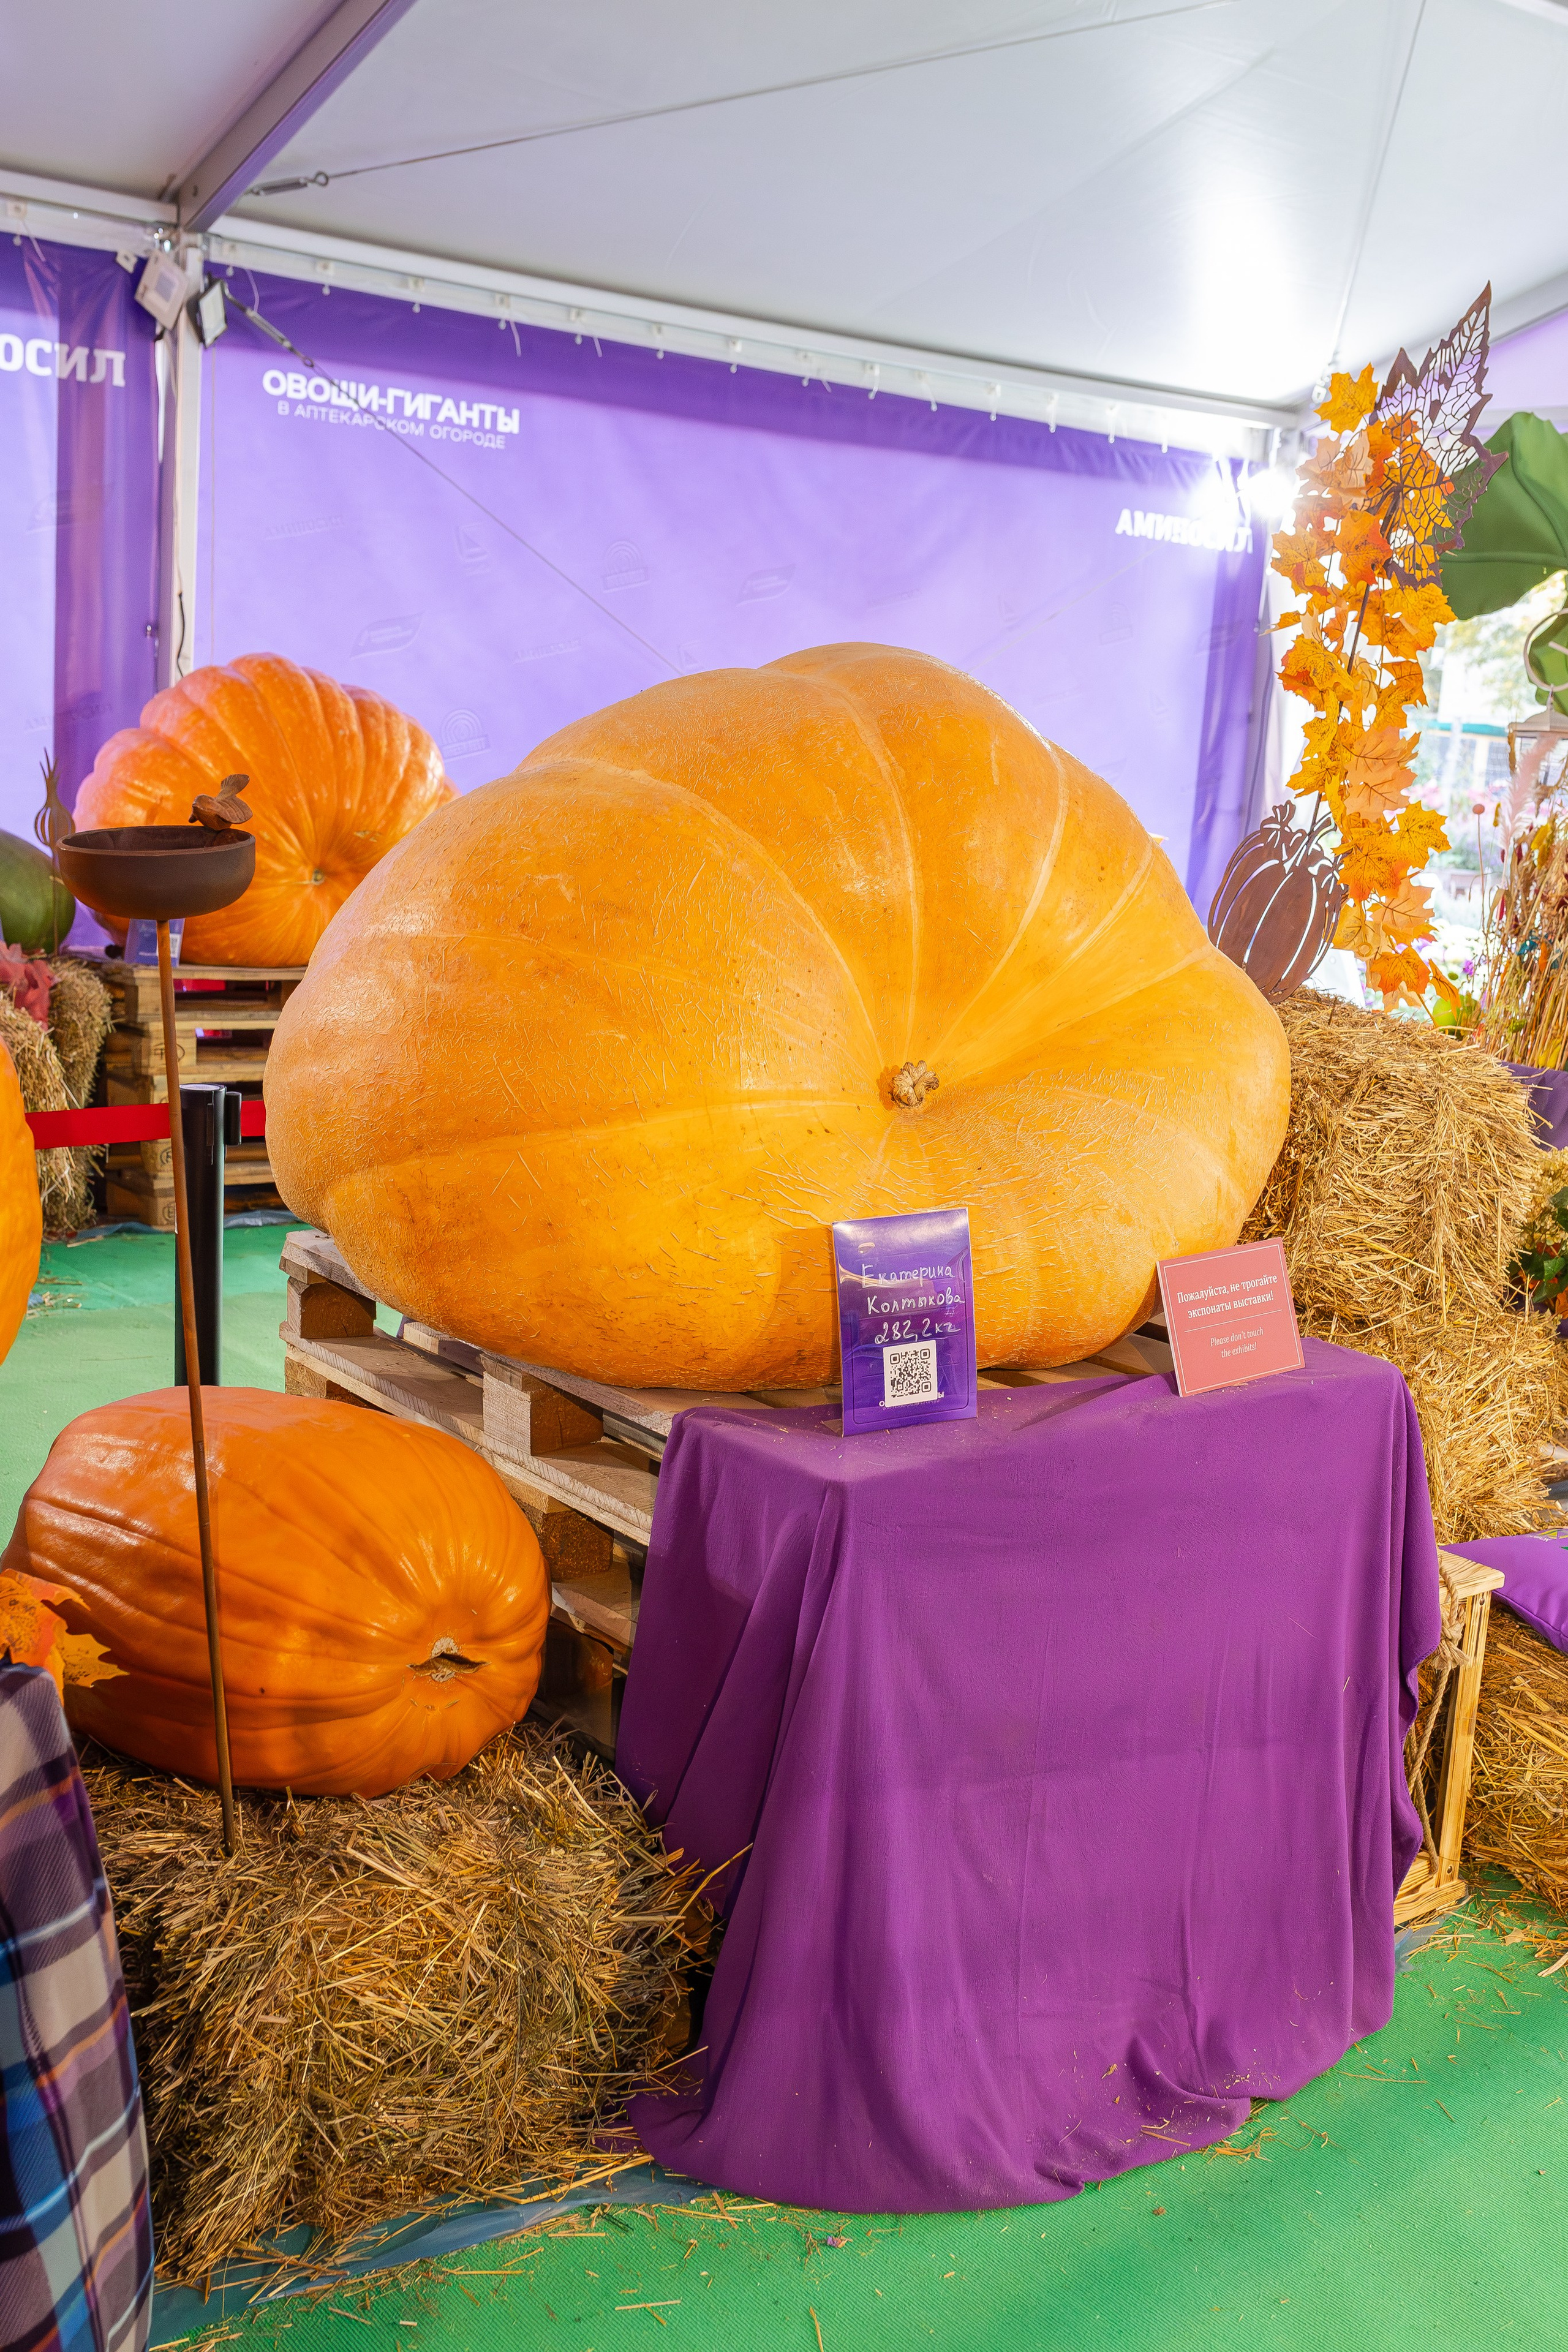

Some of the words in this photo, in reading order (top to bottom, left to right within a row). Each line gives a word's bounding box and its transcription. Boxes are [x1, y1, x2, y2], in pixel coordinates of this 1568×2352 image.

[263, 369, 520, 434] ОВОЩИ-ГИГАНТЫ
[277, 400, 290, 416] В
[294, 404, 424, 437] АПТЕКАРСКОМ
[429, 424, 506, 450] ОГОРОДЕ
[862, 1263, 956, 1288] Екатерина
[1177, 1286, 1229, 1303] Пожалуйста,
[1230, 1283, 1240, 1292] не
[1241, 1274, 1278, 1291] трогайте
[1187, 1302, 1231, 1319] экспонаты
[1233, 1290, 1274, 1309] выставки!
[1210, 1336, 1229, 1347] Please
[1231, 1330, 1246, 1342] don't
[1247, 1327, 1264, 1338] touch
[1221, 1349, 1231, 1358] the
[1232, 1341, 1257, 1355] exhibits!
